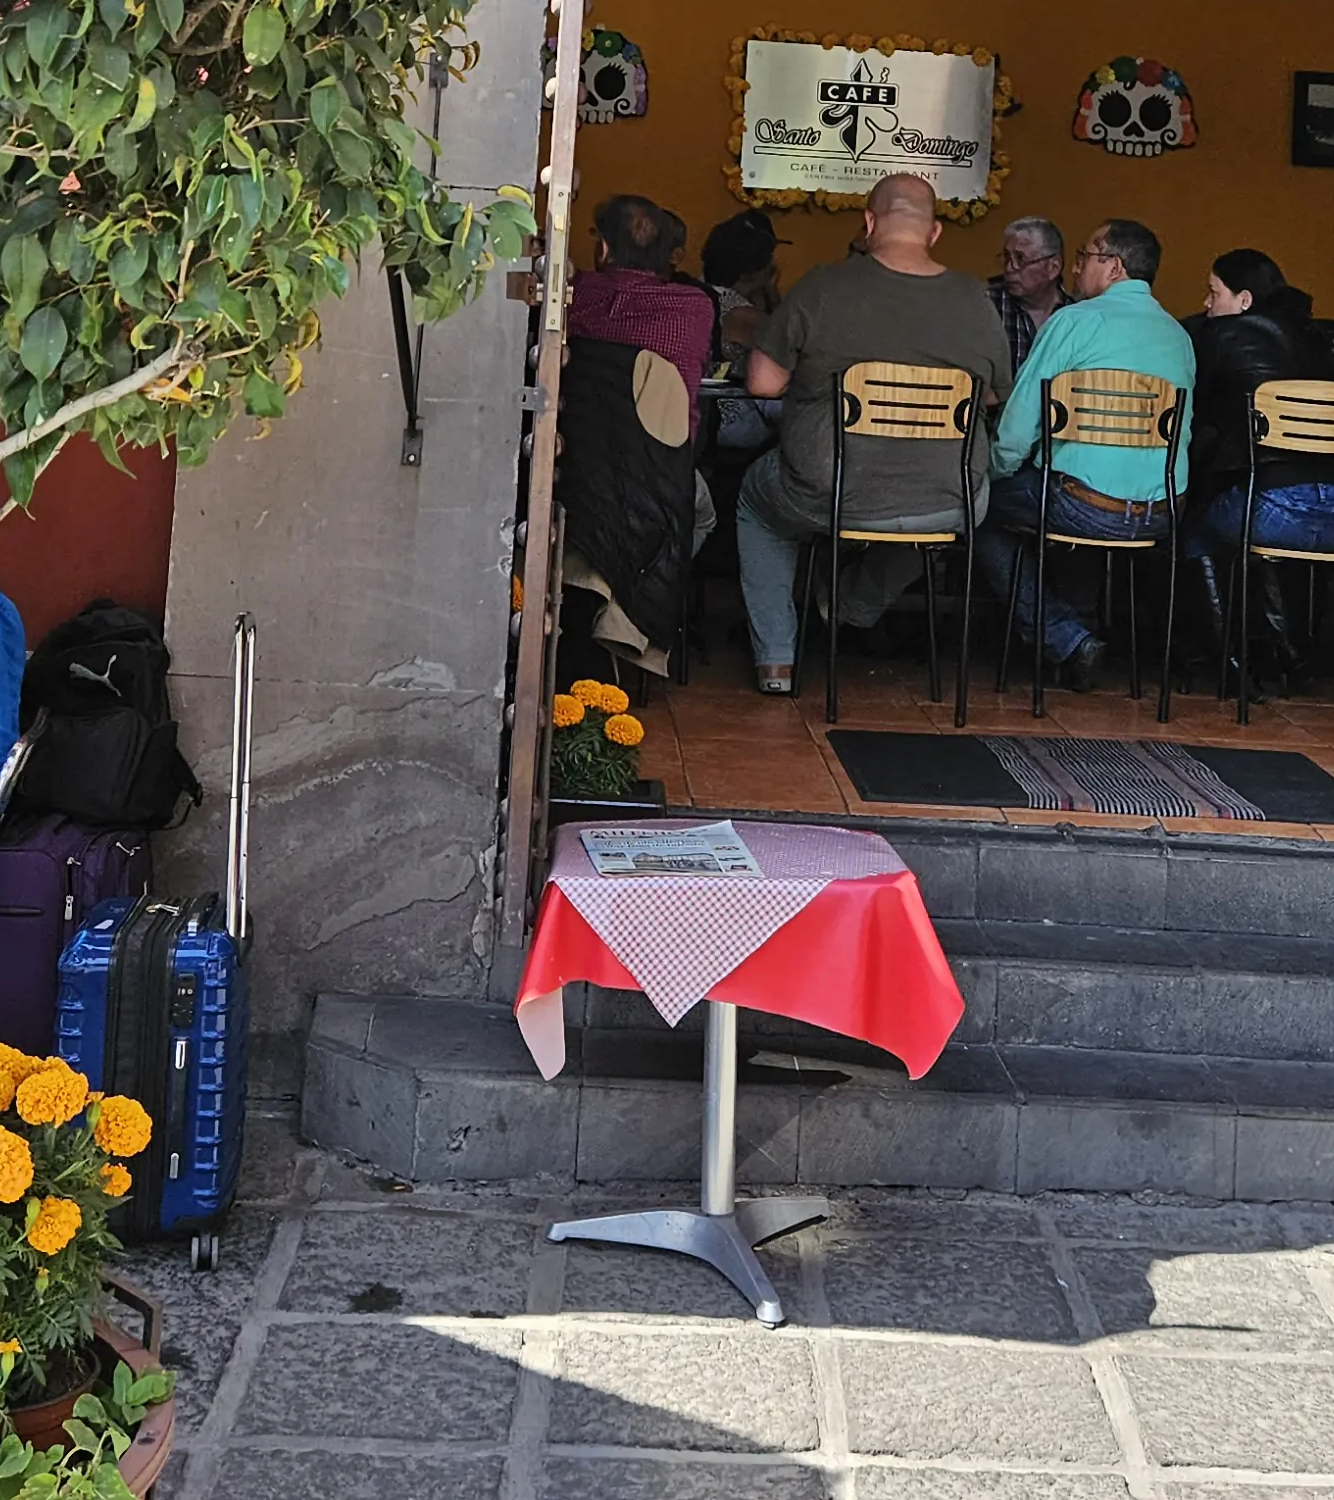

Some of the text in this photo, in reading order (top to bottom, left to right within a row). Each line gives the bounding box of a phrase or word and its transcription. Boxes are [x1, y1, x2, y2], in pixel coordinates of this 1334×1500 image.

[754, 118, 980, 164] Santo Domingo
[790, 162, 827, 174] CAFÉ
